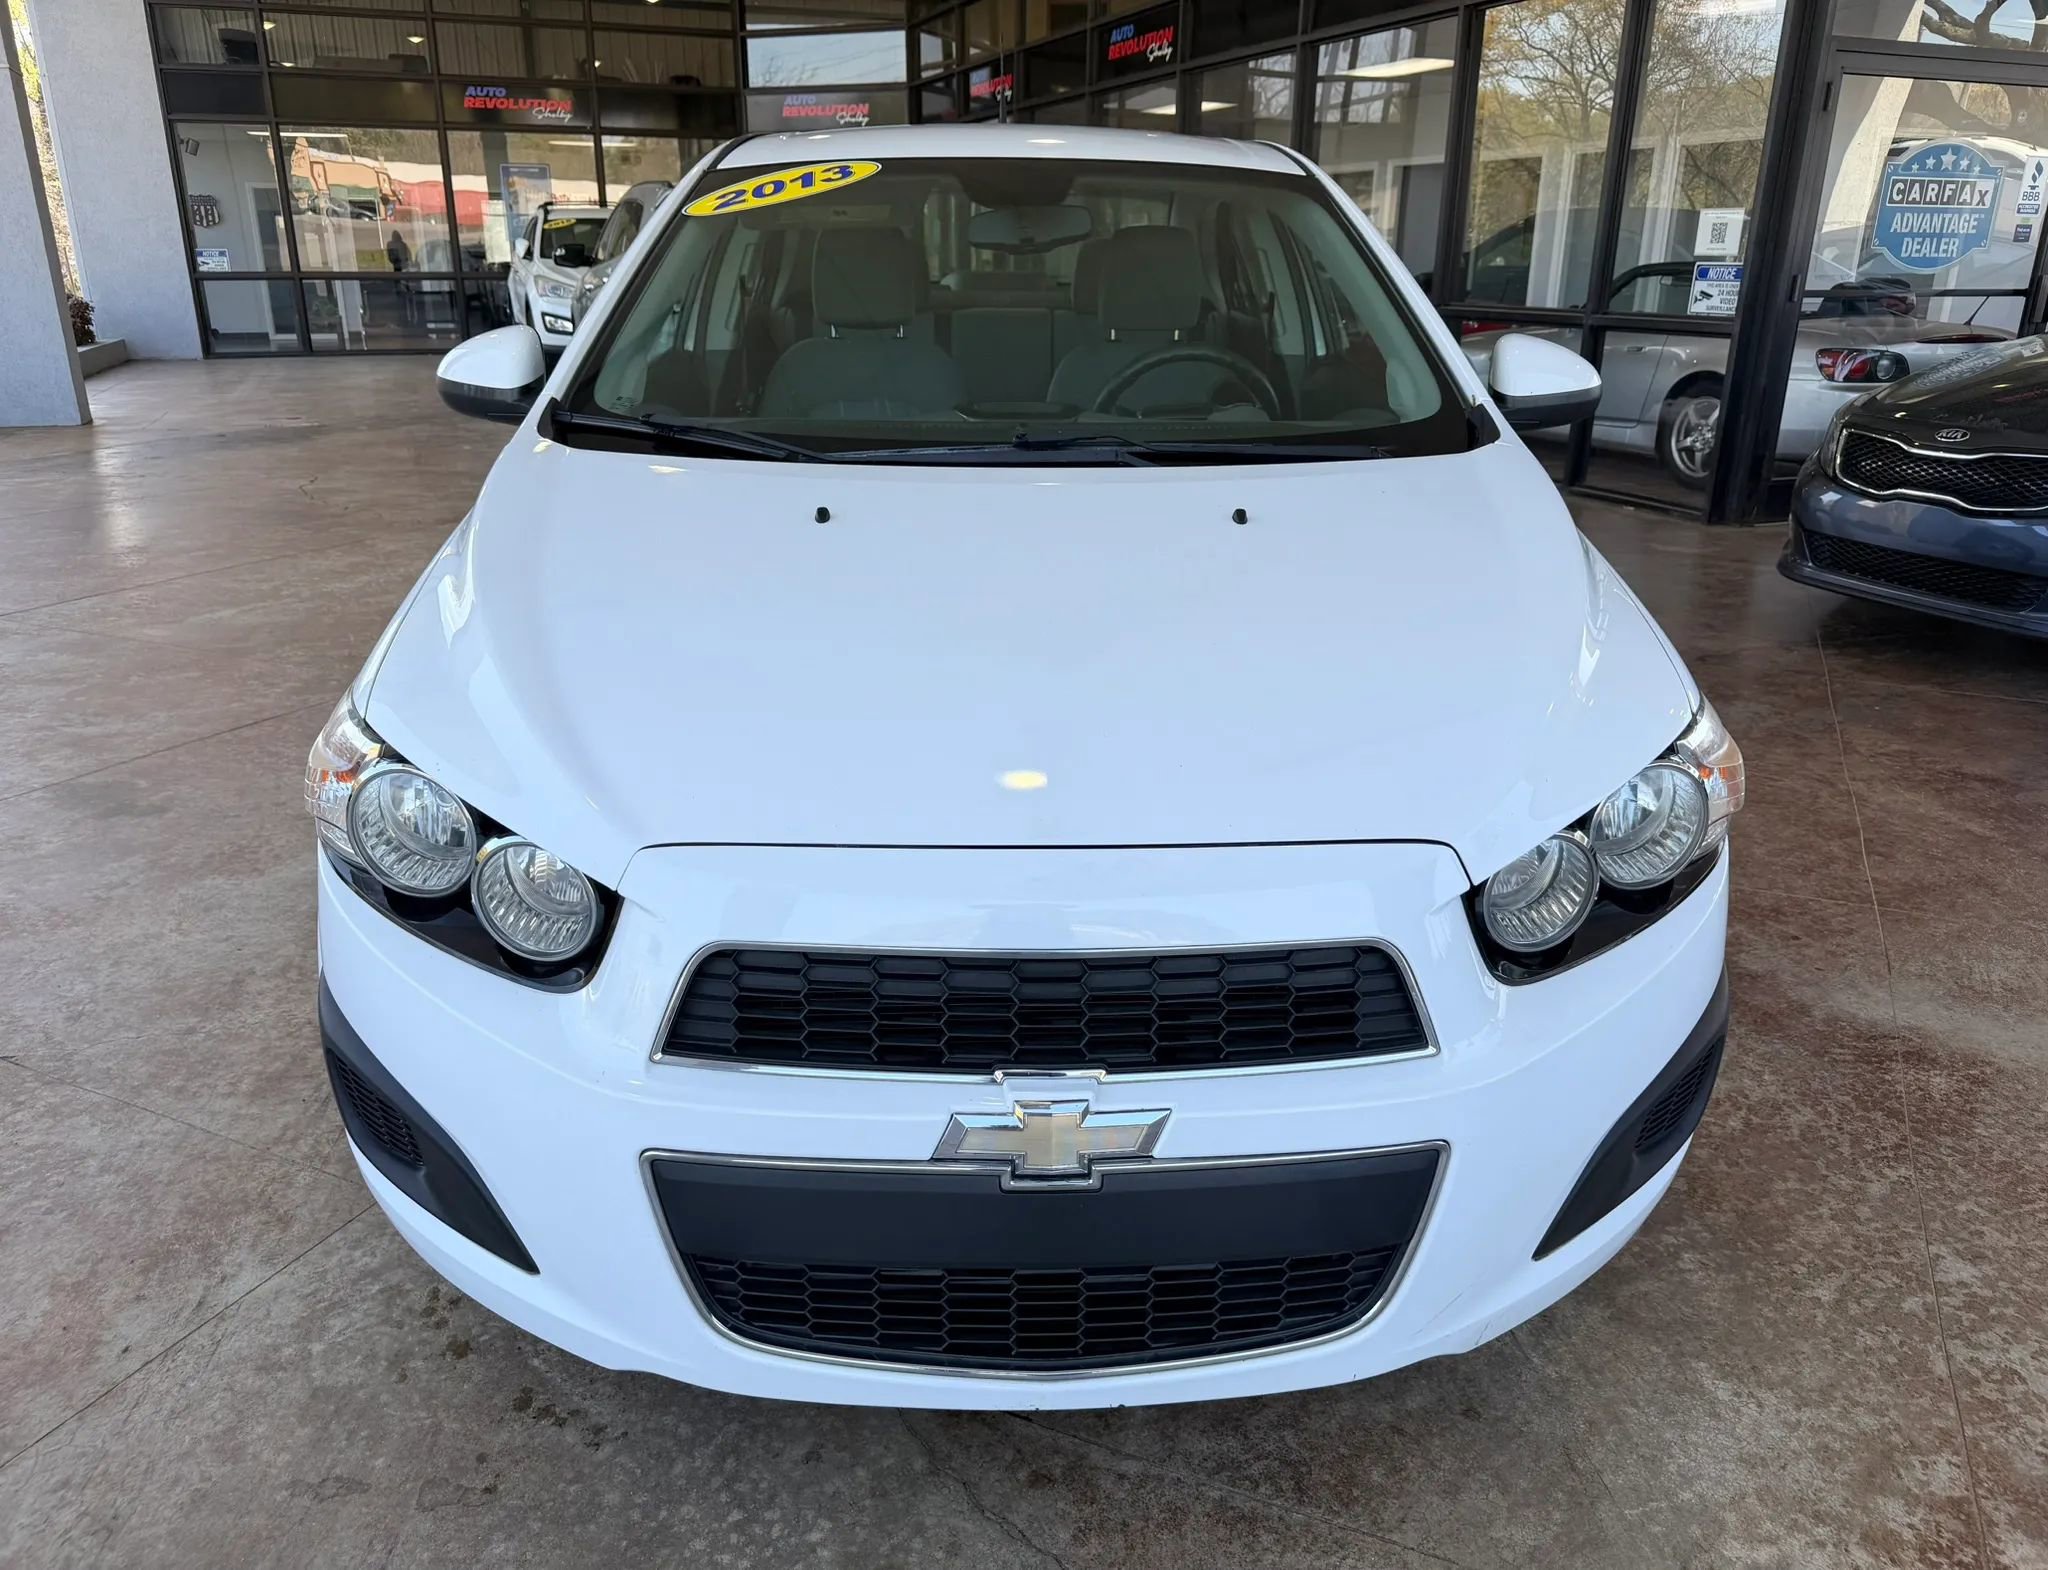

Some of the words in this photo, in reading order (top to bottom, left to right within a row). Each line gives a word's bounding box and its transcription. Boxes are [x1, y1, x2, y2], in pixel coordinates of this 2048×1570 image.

[1110, 23, 1135, 44] AUTO
[1108, 25, 1174, 60] REVOLUTION
[465, 86, 507, 97] AUTO
[463, 97, 573, 111] REVOLUTION
[784, 95, 817, 105] AUTO
[782, 103, 870, 117] REVOLUTION
[711, 164, 856, 211] 2013
[1892, 182, 1990, 206] CARFAX
[2022, 191, 2040, 201] BBB
[1890, 212, 1979, 234] ADVANTAGE
[1901, 237, 1960, 257] DEALER
[1707, 267, 1738, 280] NOTICE
[1720, 297, 1736, 305] VIDEO
